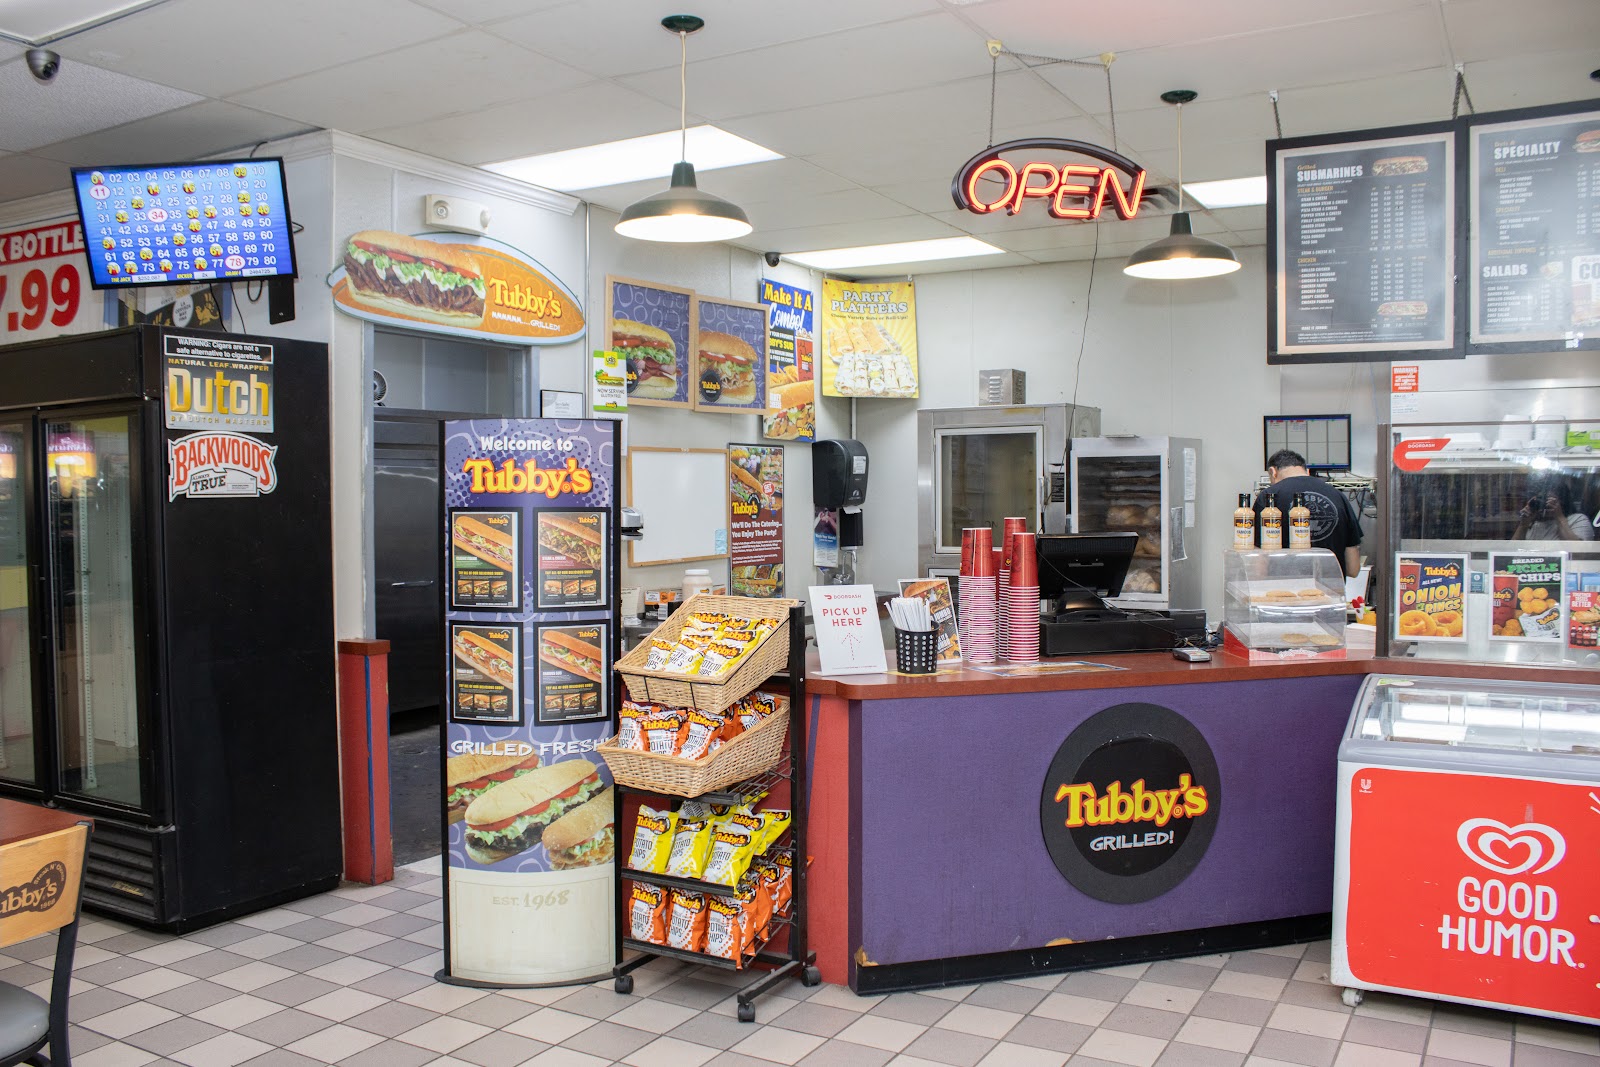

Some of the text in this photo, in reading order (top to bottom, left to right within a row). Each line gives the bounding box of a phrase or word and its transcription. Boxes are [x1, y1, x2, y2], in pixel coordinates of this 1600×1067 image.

[1494, 141, 1561, 160] SPECIALTY
[1297, 165, 1363, 182] SUBMARINES
[968, 158, 1147, 219] OPEN
[98, 207, 234, 222] 31 33 34 35 38
[100, 218, 271, 235] 41 42 43 44 45 47 48 49 50
[120, 231, 273, 247] 52 53 54 56 57 58 59 60
[105, 243, 275, 260] 61 62 64 65 66 68 69 70
[142, 256, 276, 272] 73 75 77 78 79 80
[1483, 264, 1528, 278] SALADS
[489, 276, 562, 319] Tubby's
[764, 283, 812, 311] Make It A
[842, 290, 893, 302] PARTY
[831, 300, 908, 314] PLATTERS
[178, 338, 211, 347] WARNING:
[212, 341, 232, 350] Cigars
[784, 341, 794, 350] SUB
[191, 348, 223, 357] alternative
[231, 351, 262, 360] cigarettes.
[168, 357, 206, 367] NATURAL
[168, 367, 269, 416] Dutch
[480, 436, 573, 451] Welcome to
[174, 437, 271, 486] BACKWOODS
[192, 475, 226, 492] TRUE
[463, 457, 593, 499] Tubby's
[732, 501, 758, 516] Tubby's
[732, 521, 744, 529] We'll
[742, 530, 754, 538] Enjoy
[764, 529, 777, 537] Party!
[1424, 566, 1458, 577] Tubby's
[1507, 563, 1558, 573] PICKLE
[1519, 573, 1561, 582] CHIPS
[1402, 583, 1461, 605] ONION
[822, 607, 868, 617] PICK UP
[1425, 599, 1461, 613] RINGS
[832, 618, 862, 627] HERE
[642, 718, 679, 730] Tubby's
[688, 711, 719, 727] Tubby's
[450, 739, 533, 757] GRILLED
[1055, 773, 1208, 828] Tubby's
[637, 816, 665, 831] Tubby's
[733, 814, 759, 828] Tubby's
[715, 832, 745, 845] Tubby's
[1089, 830, 1174, 851] GRILLED!
[492, 889, 571, 911] EST. 1968
[633, 888, 657, 906] Tubby's
[672, 891, 700, 910] Tubby's
[1457, 876, 1558, 922] GOOD
[709, 900, 737, 915] Tubby's
[1438, 914, 1577, 967] HUMOR
